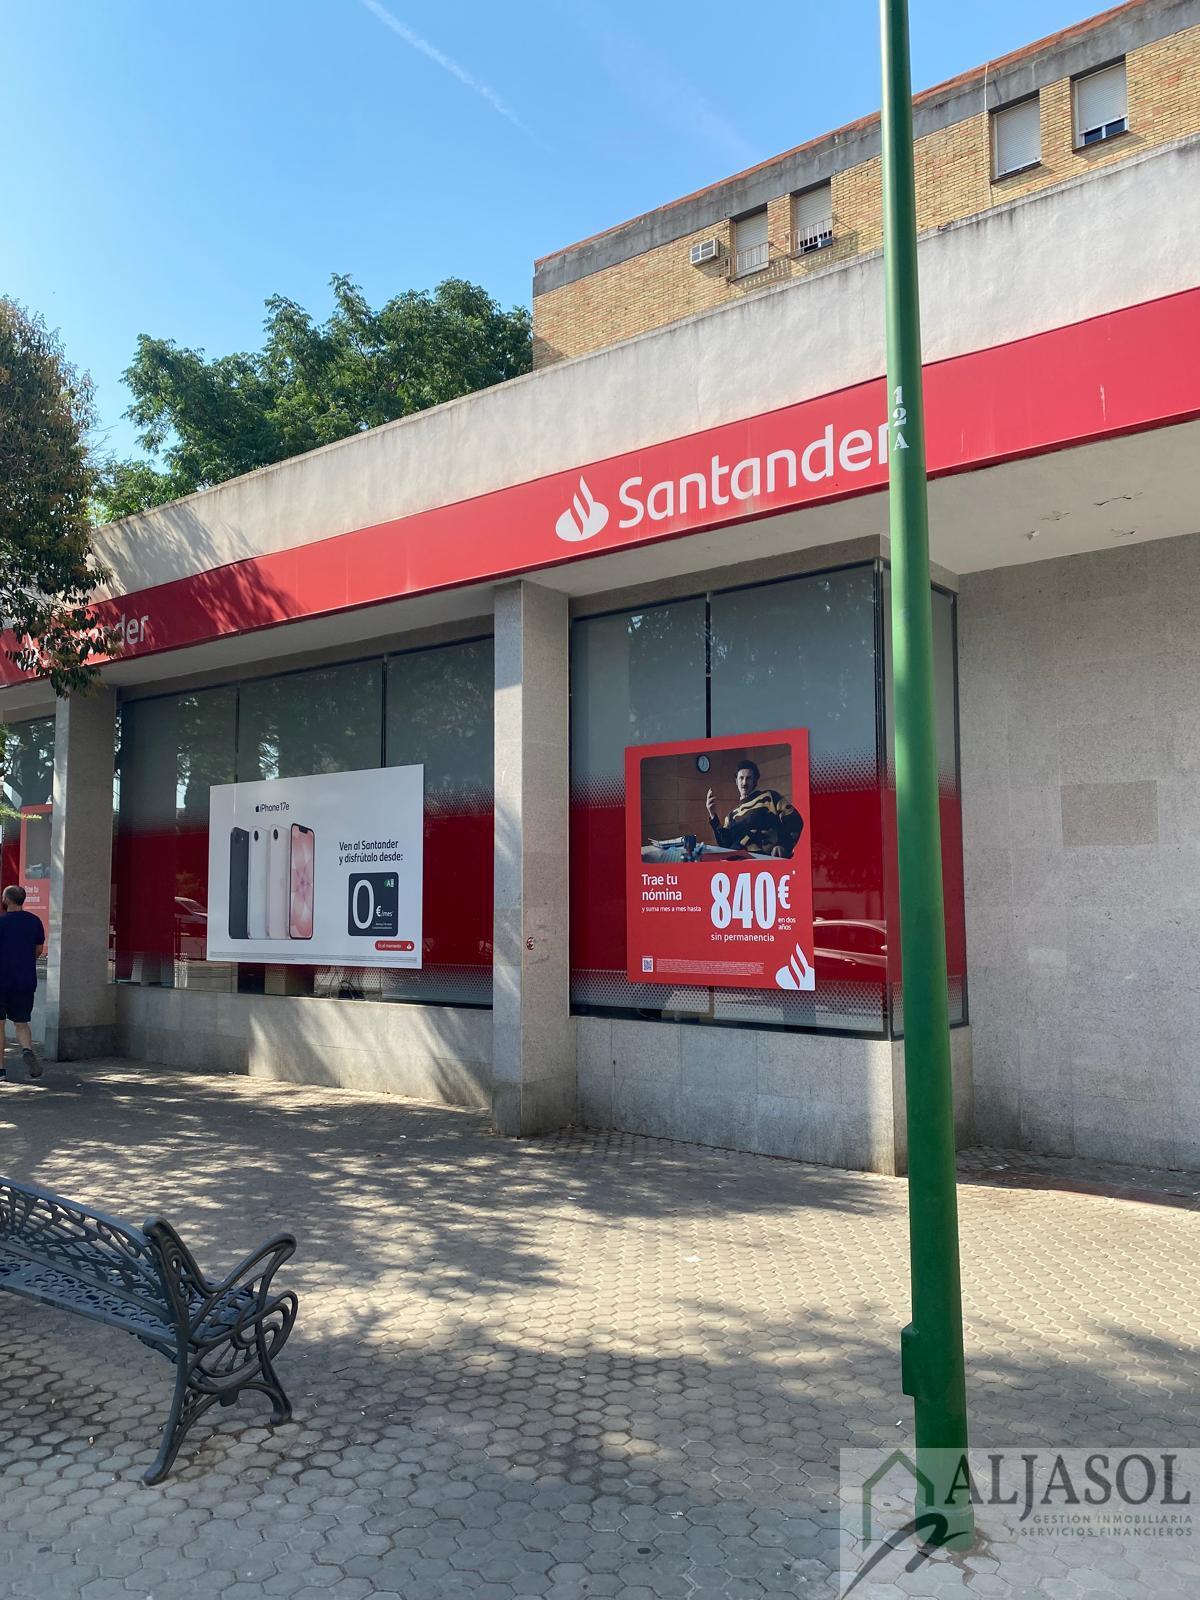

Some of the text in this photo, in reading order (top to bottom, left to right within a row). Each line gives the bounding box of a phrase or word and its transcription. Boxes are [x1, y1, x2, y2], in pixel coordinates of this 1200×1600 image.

[618, 423, 889, 529] Santander
[259, 803, 279, 812] iPhone
[339, 840, 399, 851] Ven al Santander
[338, 851, 404, 866] y disfrútalo desde:
[641, 873, 678, 885] Trae tu
[642, 888, 682, 901] nómina
[711, 932, 775, 943] sin permanencia
